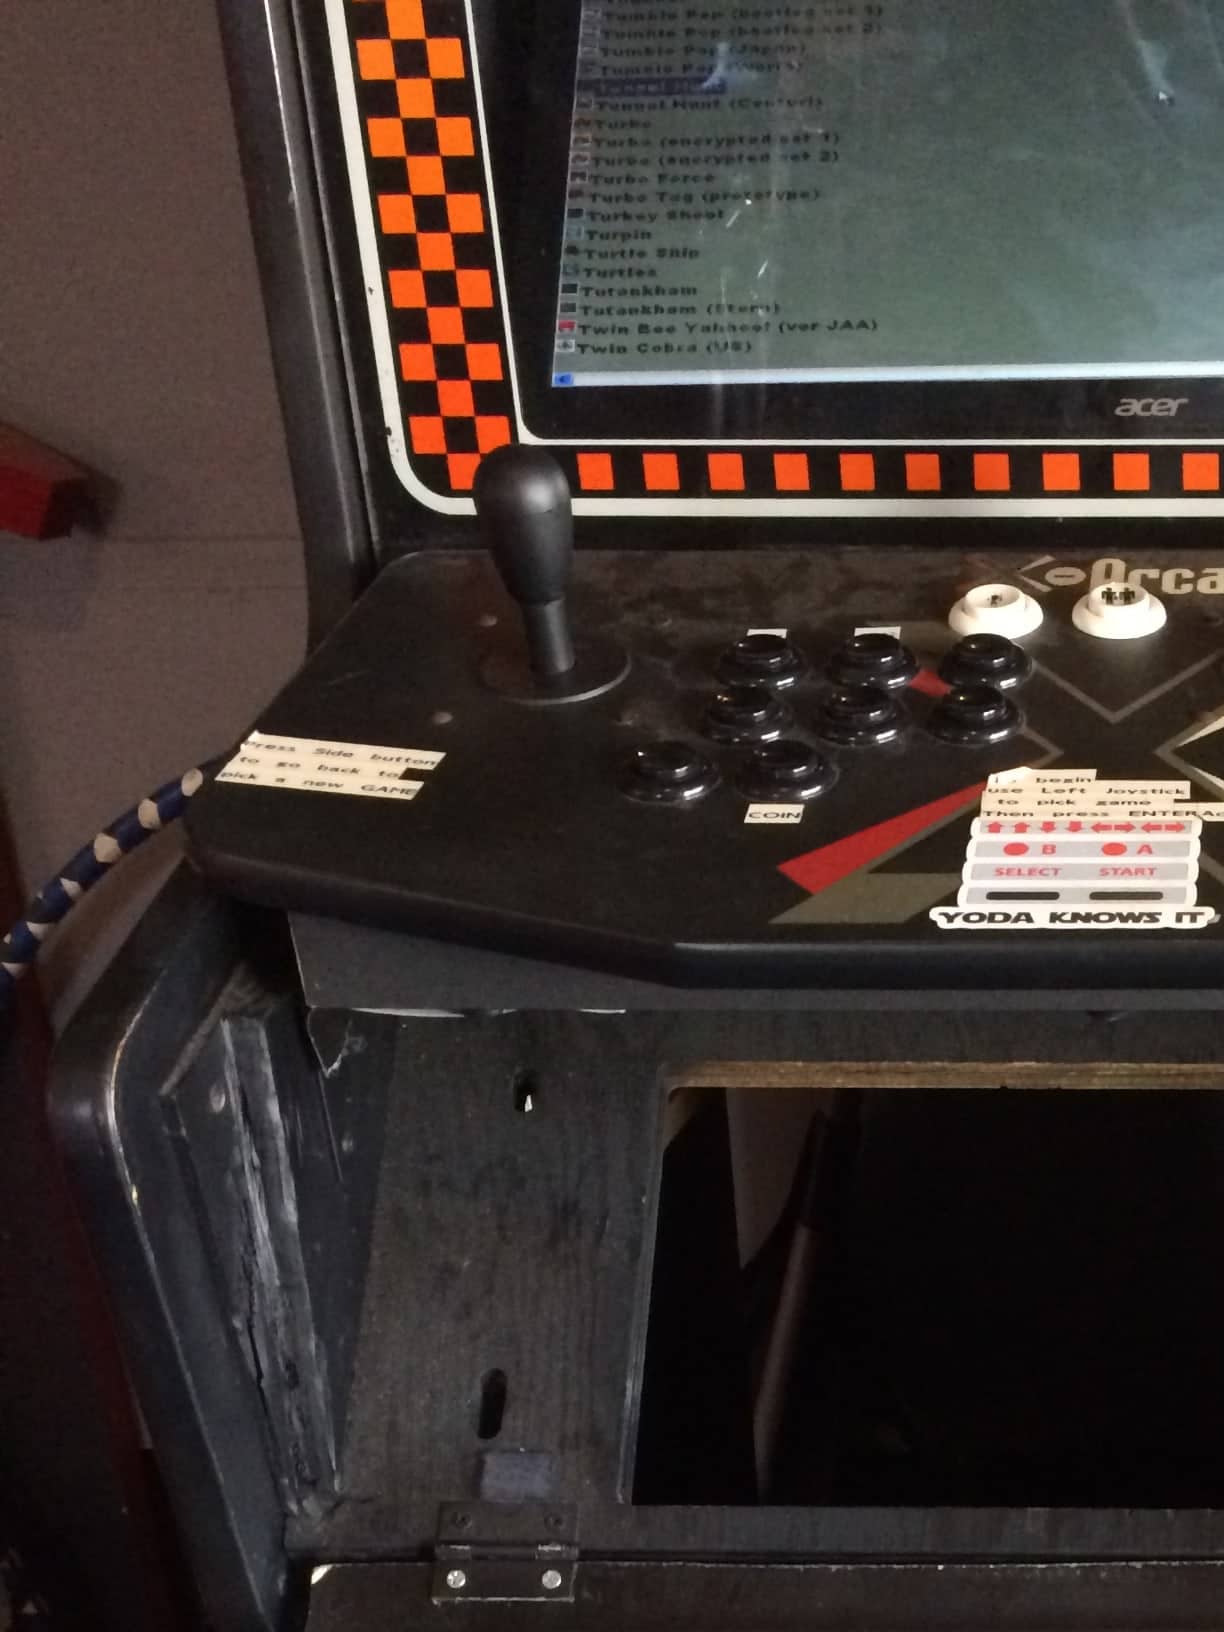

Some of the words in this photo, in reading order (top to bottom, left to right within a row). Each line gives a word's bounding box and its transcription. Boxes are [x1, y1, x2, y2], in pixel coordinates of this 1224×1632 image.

[1114, 398, 1189, 416] acer
[313, 747, 354, 758] Side
[370, 754, 437, 766] button
[317, 764, 360, 775] back
[303, 780, 344, 788] new
[1036, 777, 1092, 785] begin
[1041, 786, 1087, 794] Left
[1106, 787, 1186, 795] Joystick
[1096, 799, 1152, 807] game
[1041, 844, 1057, 855] B
[1136, 844, 1154, 855] A
[994, 867, 1062, 877] SELECT
[1099, 867, 1157, 877] START
[938, 911, 1035, 924] YODA
[1049, 911, 1163, 924] KNOWS
[1175, 911, 1206, 924] IT
